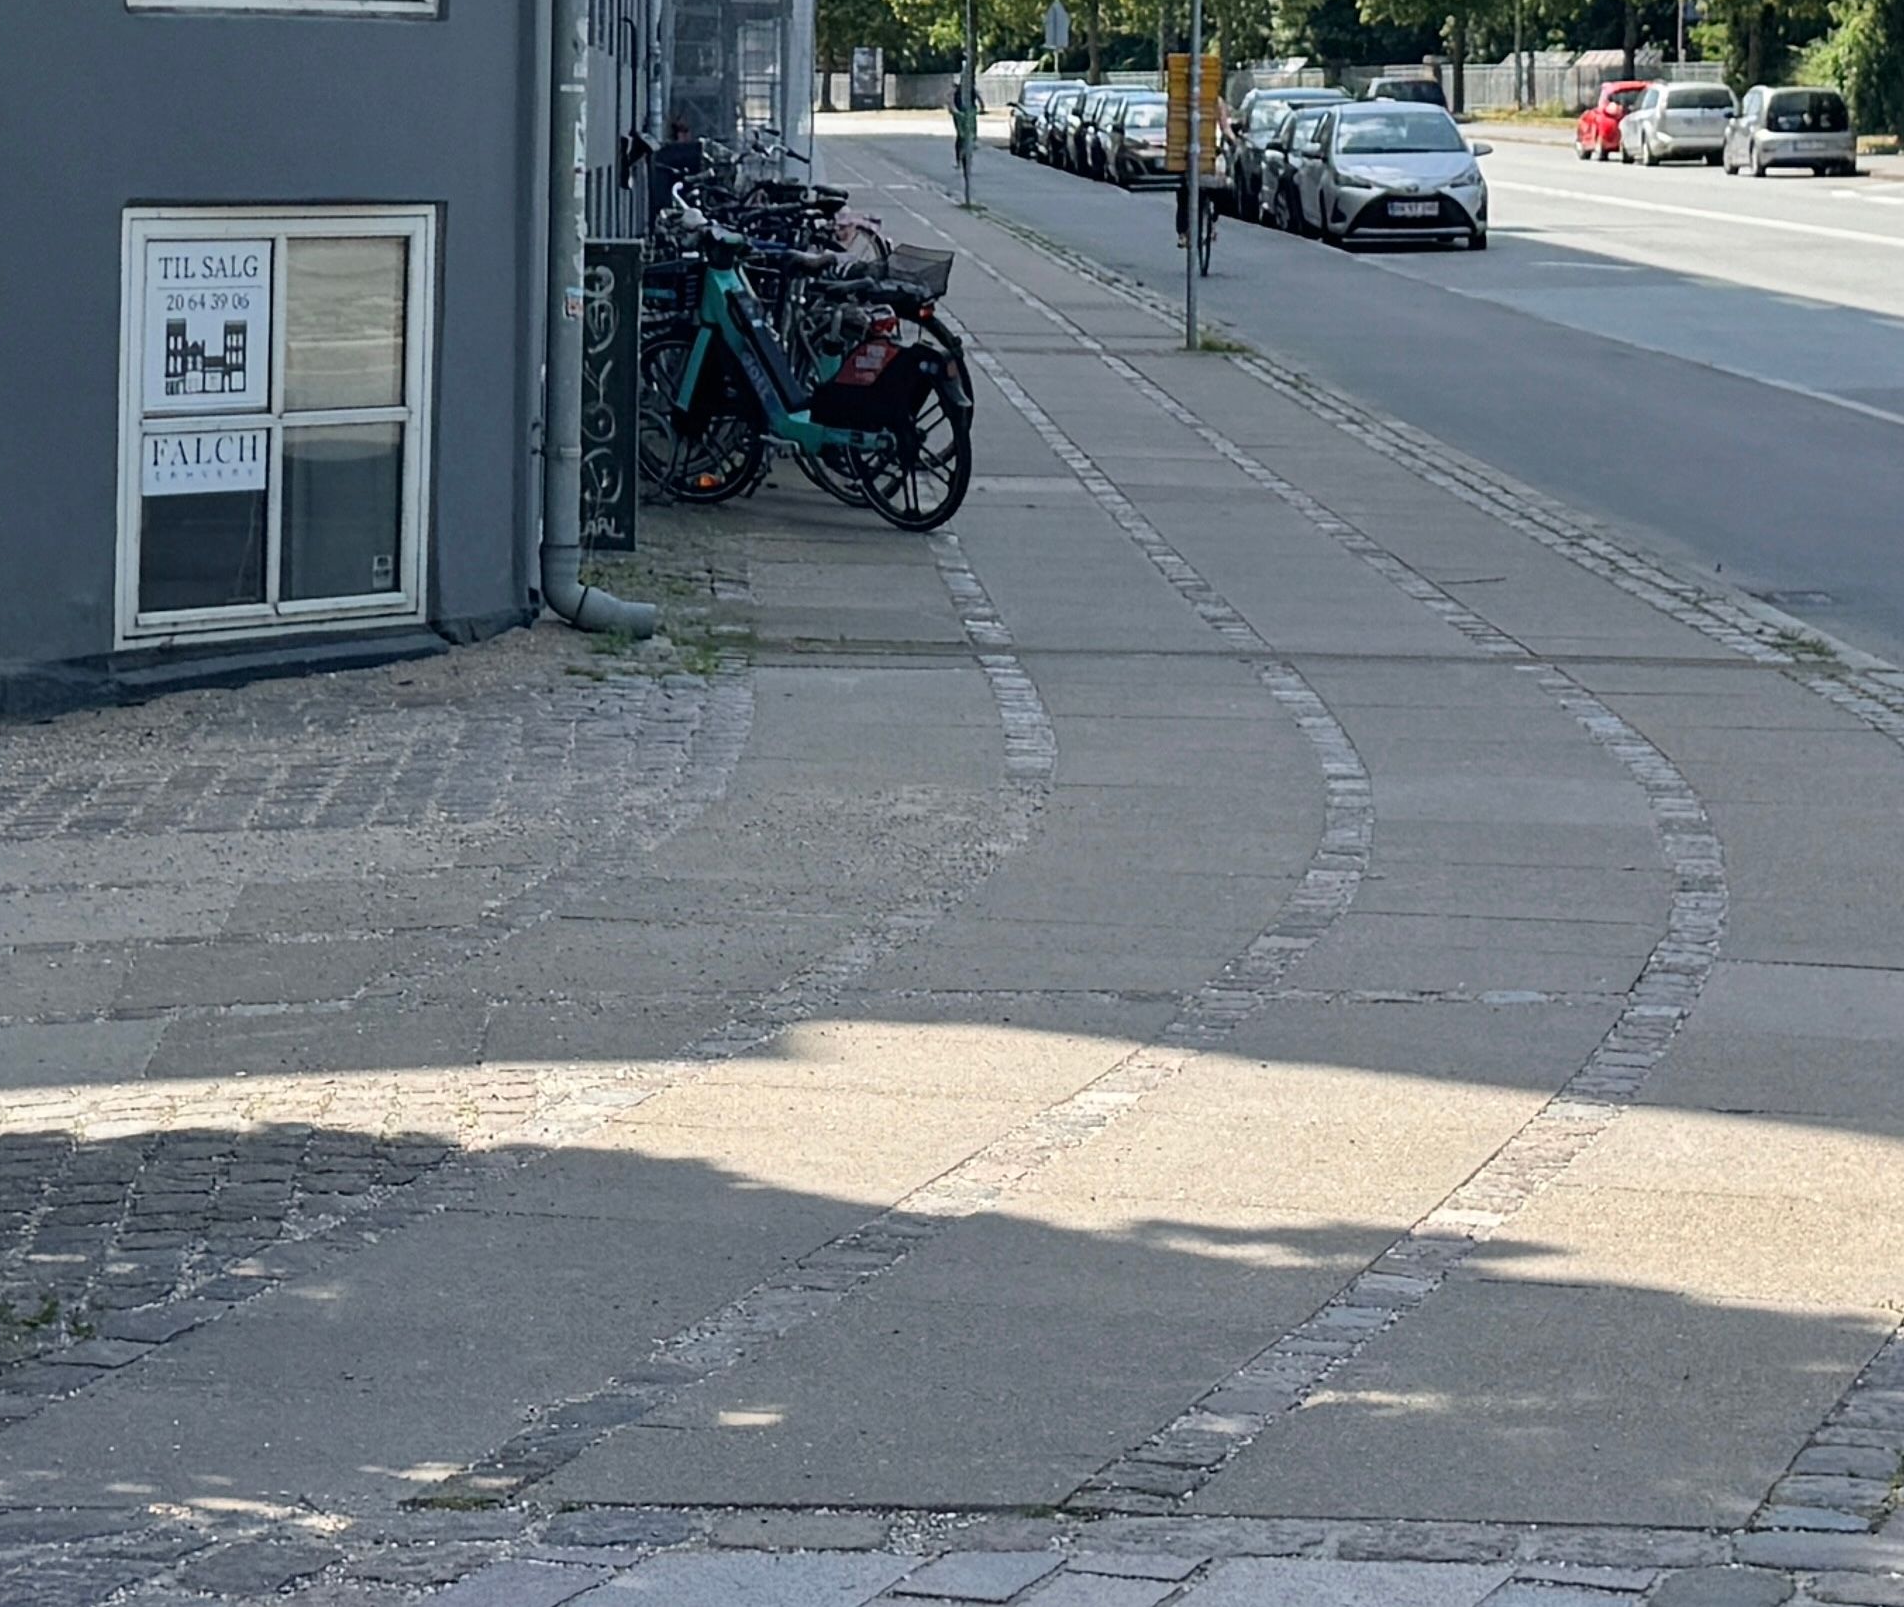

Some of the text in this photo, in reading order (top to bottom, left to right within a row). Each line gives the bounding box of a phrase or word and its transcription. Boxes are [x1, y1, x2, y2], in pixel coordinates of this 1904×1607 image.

[158, 255, 258, 280] TIL SALG
[166, 294, 185, 311] 20
[153, 434, 257, 467] FALCH
